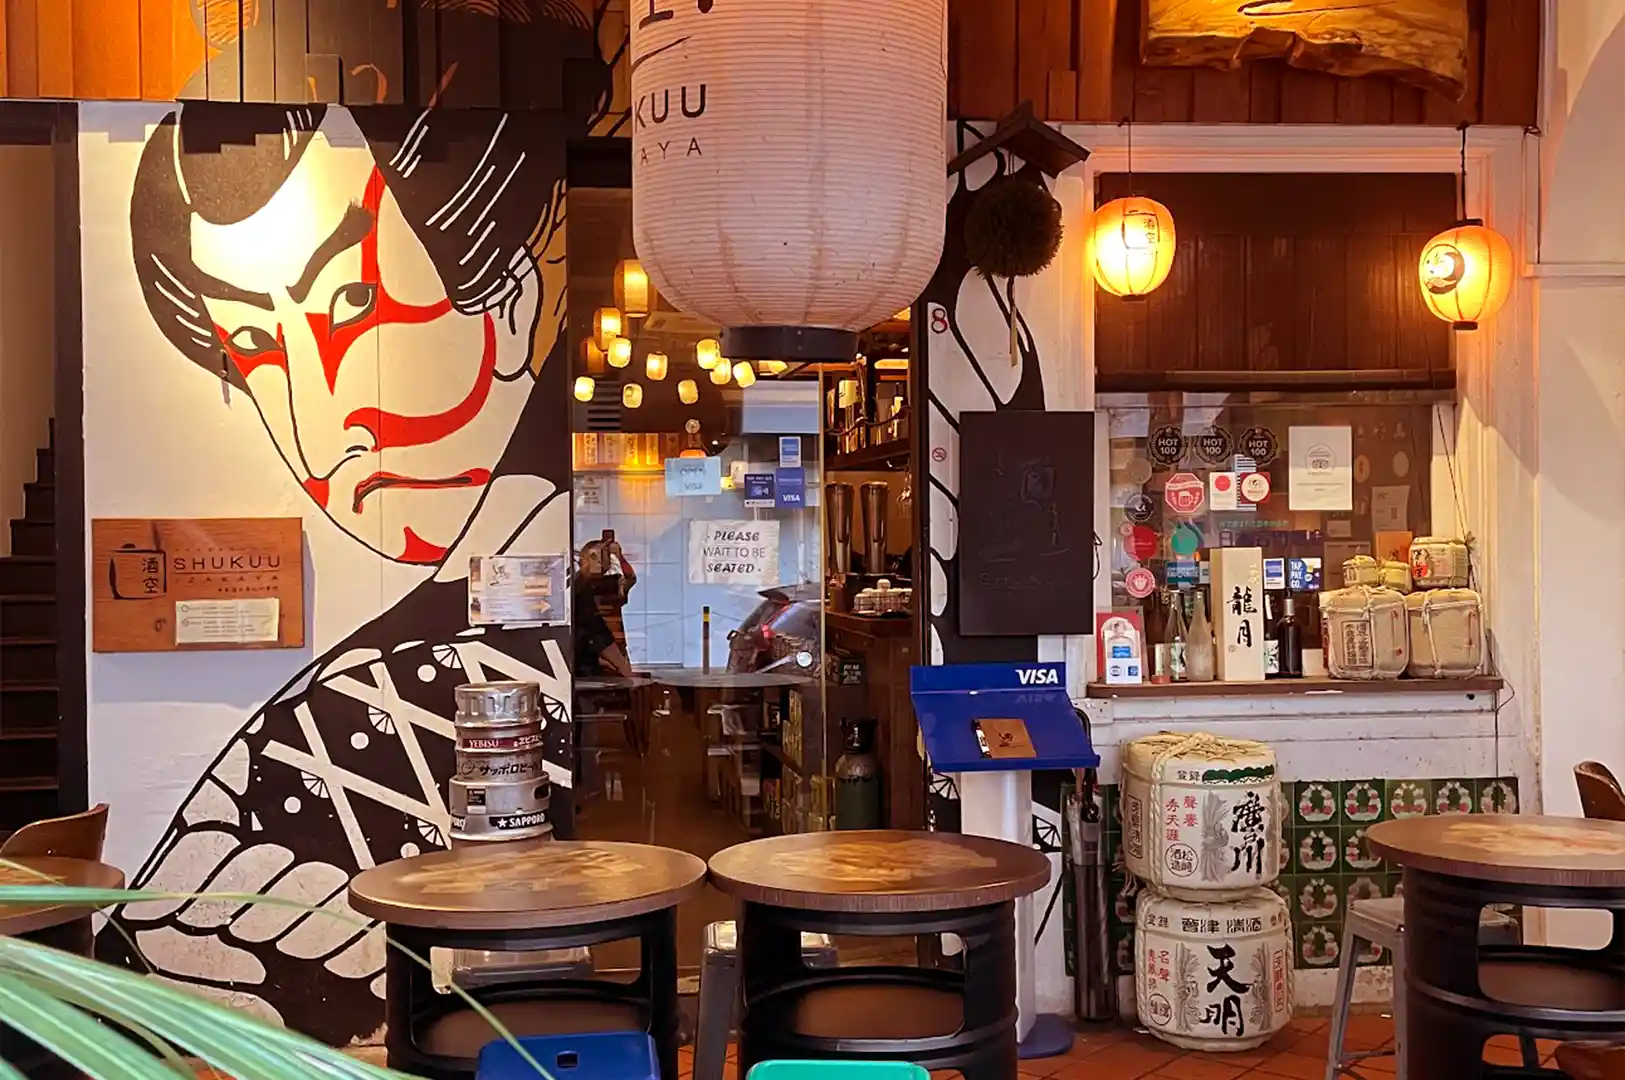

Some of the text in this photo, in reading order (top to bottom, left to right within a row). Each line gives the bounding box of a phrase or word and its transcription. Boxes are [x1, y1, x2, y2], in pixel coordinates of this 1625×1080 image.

[931, 308, 948, 334] 8
[1158, 438, 1178, 447] HOT
[1204, 438, 1224, 447] HOT
[1249, 440, 1269, 449] HOT
[1160, 446, 1176, 455] 100
[1206, 446, 1222, 455] 100
[1251, 448, 1267, 457] 100
[782, 494, 801, 502] VISA
[713, 531, 760, 542] PLEASE
[703, 547, 765, 558] WAIT TO BE
[173, 555, 281, 571] SHUKUU
[707, 563, 755, 574] SEATED
[142, 557, 160, 594] 酒空
[1226, 586, 1257, 648] 龍月
[1015, 669, 1058, 685] VISA
[469, 739, 499, 748] YEBISU
[509, 813, 546, 828] SAPPORO
[1200, 943, 1253, 1037] 天明
